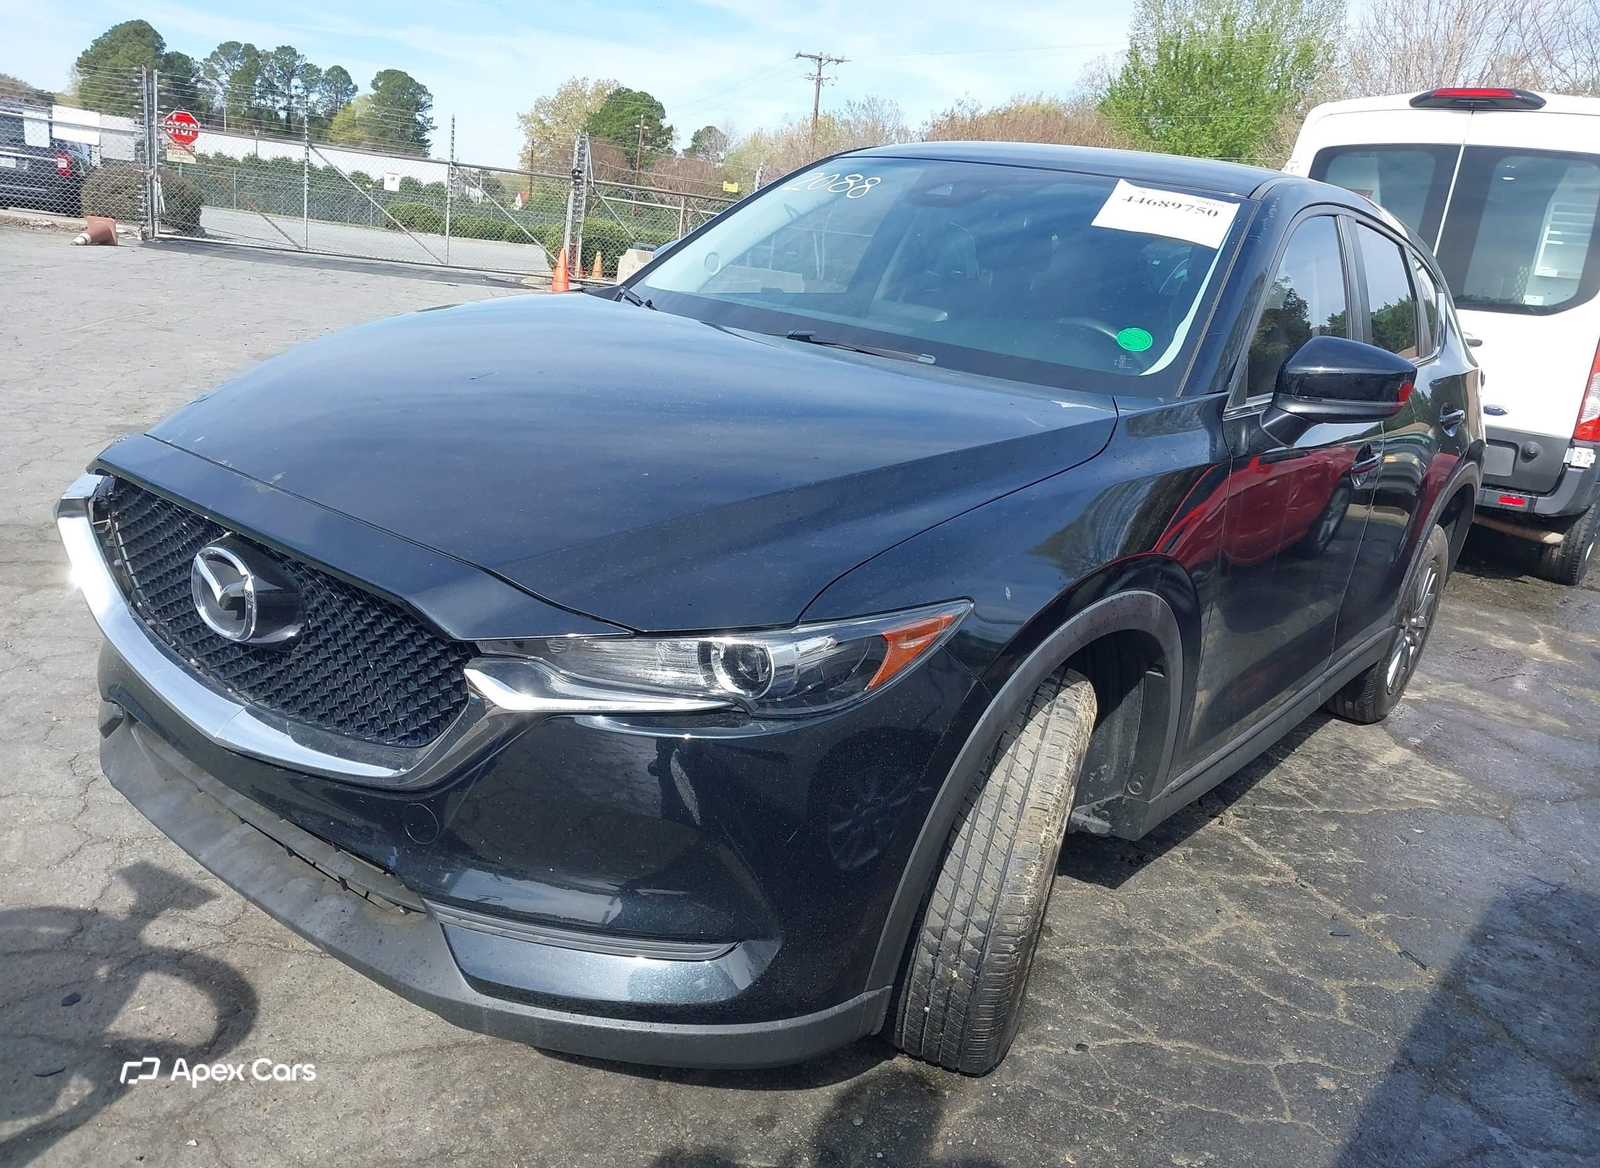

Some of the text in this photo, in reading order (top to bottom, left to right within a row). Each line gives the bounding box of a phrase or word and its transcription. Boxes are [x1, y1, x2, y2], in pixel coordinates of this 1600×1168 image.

[166, 121, 197, 136] STOP
[781, 172, 881, 199] 2088
[1122, 195, 1219, 217] 44689750
